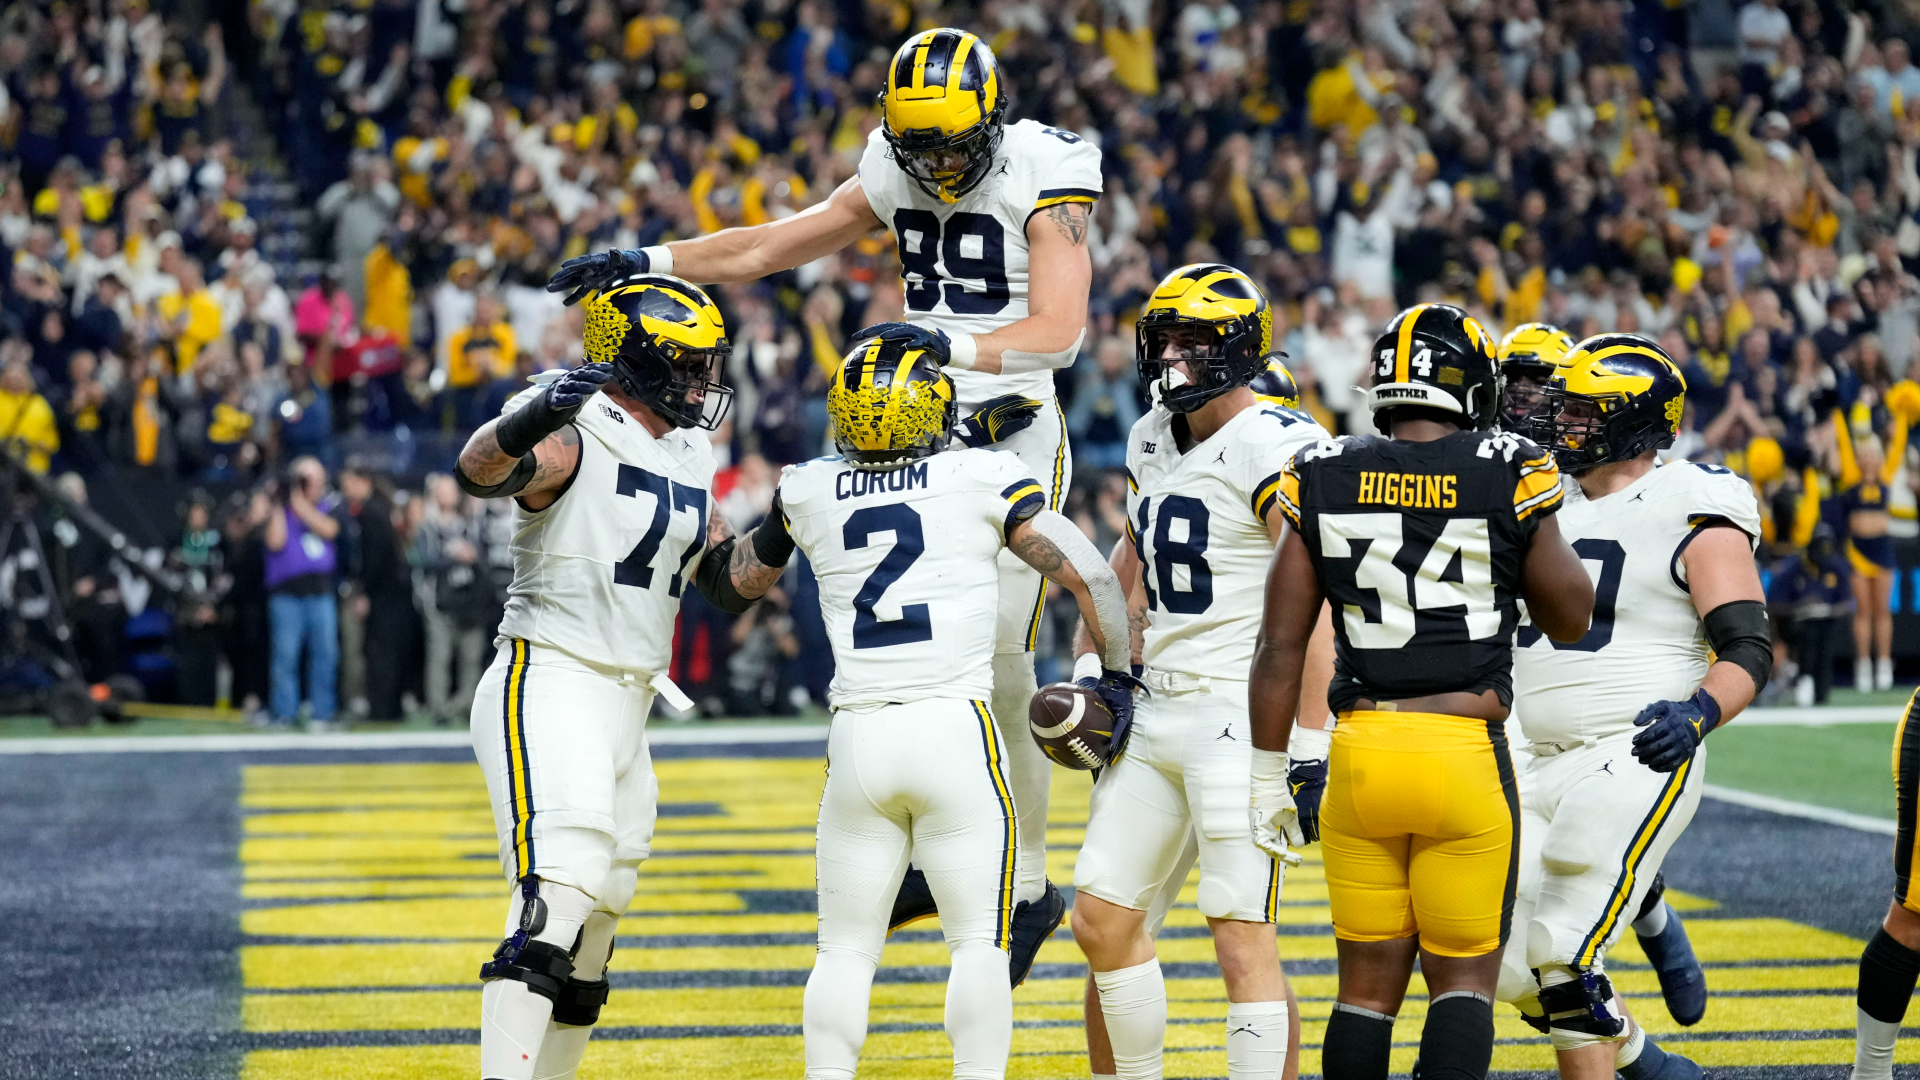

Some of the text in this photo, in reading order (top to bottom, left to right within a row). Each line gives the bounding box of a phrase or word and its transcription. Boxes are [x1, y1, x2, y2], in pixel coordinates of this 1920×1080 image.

[893, 207, 1010, 315] 89
[613, 462, 707, 599] 77
[836, 462, 928, 501] CORUM
[1357, 471, 1457, 509] HIGGINS
[842, 503, 933, 650] 2
[1135, 494, 1214, 615] 18
[1318, 512, 1501, 649] 34
